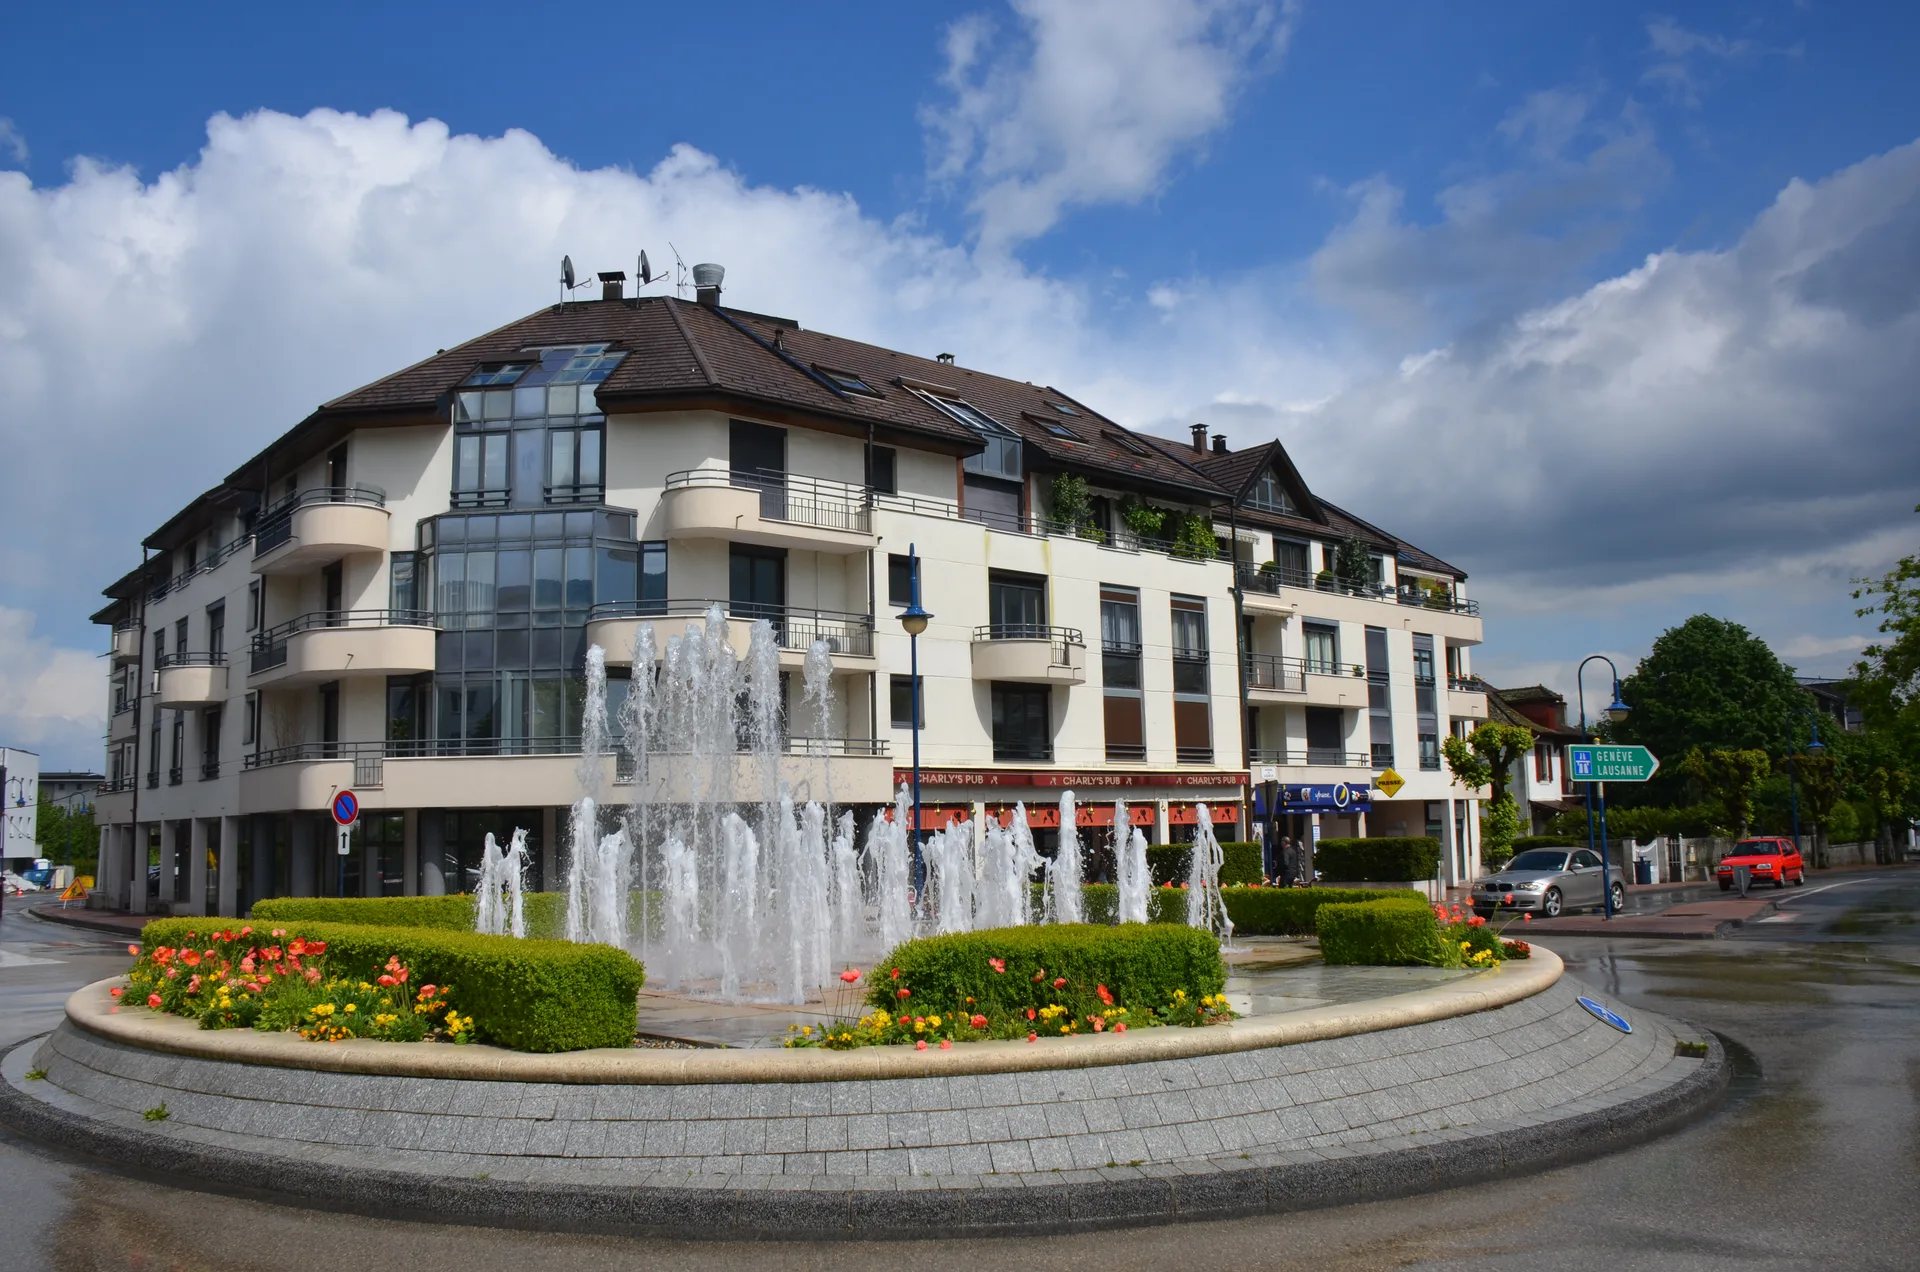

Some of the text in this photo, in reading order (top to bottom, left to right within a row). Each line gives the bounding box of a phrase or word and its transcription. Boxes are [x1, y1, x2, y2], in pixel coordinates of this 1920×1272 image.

[1597, 749, 1633, 761] GENÈVE
[1597, 765, 1644, 776] LAUSANNE
[965, 775, 984, 784] PUB
[1063, 776, 1120, 785] CHARLY'S PUB
[1187, 776, 1236, 785] CHARLY'S PUB
